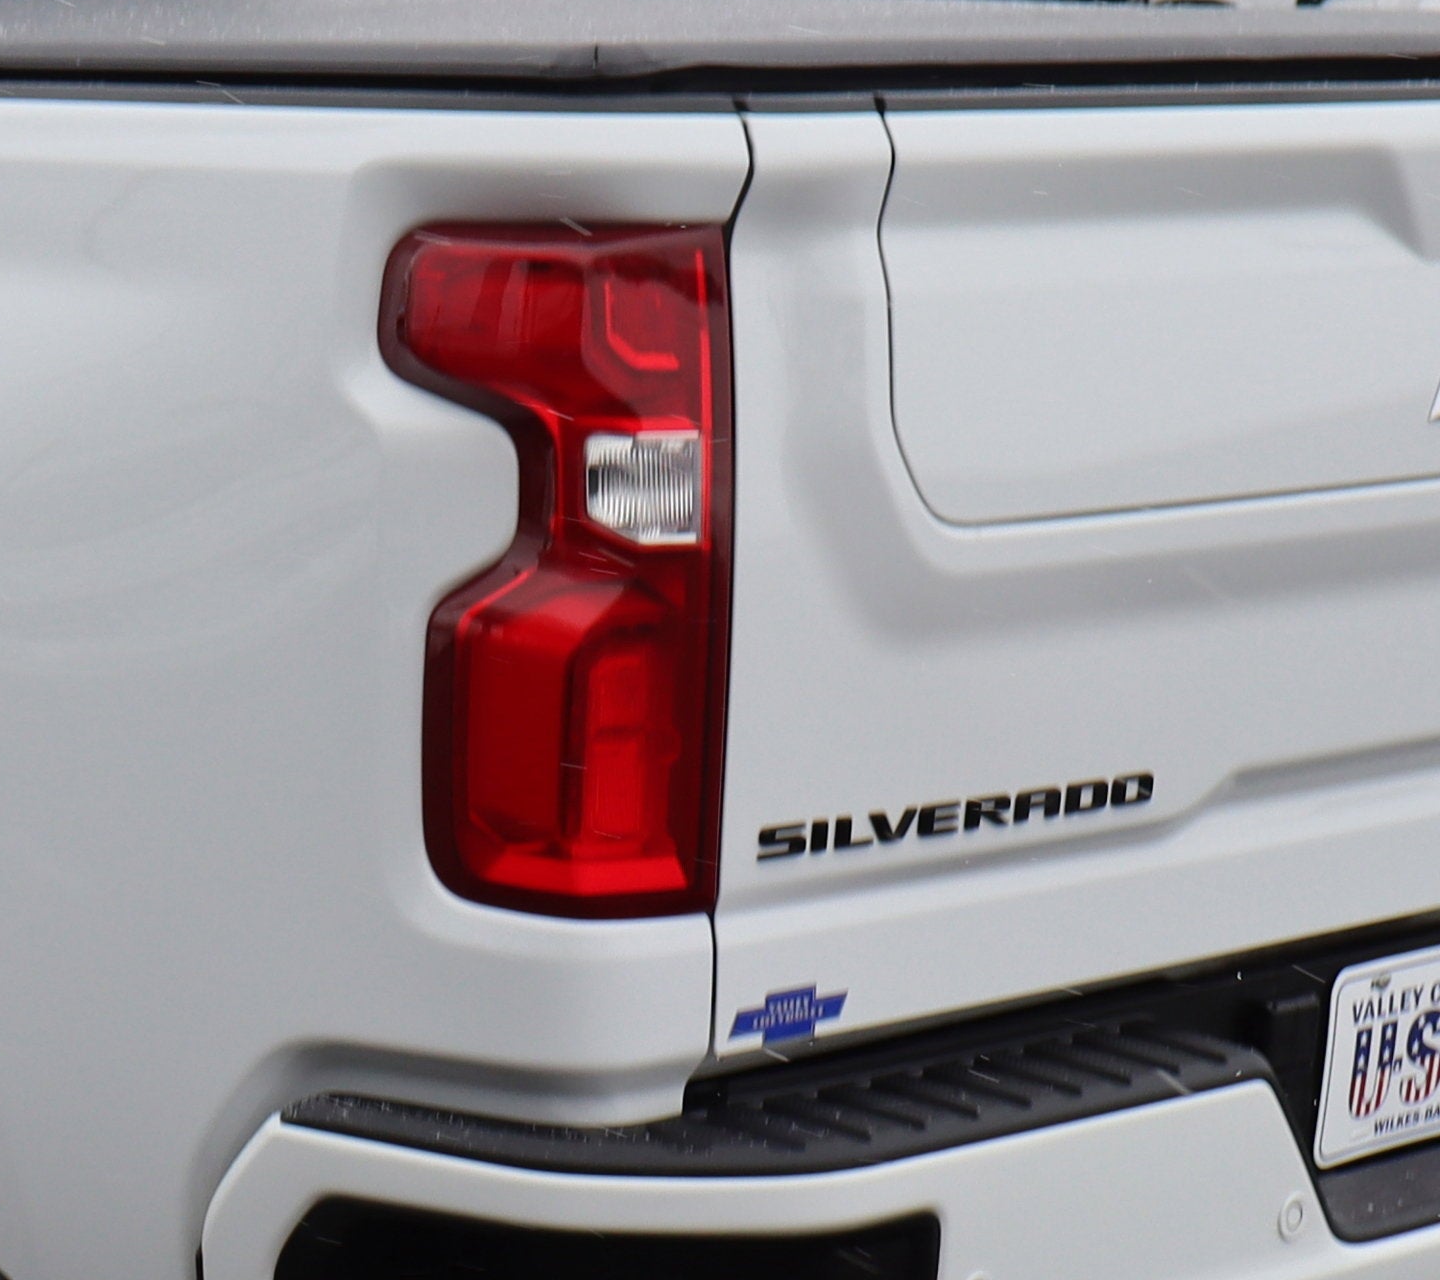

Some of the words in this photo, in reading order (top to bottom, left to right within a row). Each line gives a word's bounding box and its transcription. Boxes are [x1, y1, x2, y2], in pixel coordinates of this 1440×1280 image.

[756, 769, 1155, 863] SILVERADO
[768, 994, 811, 1017] VALLEY
[1352, 983, 1425, 1026] VALLEY
